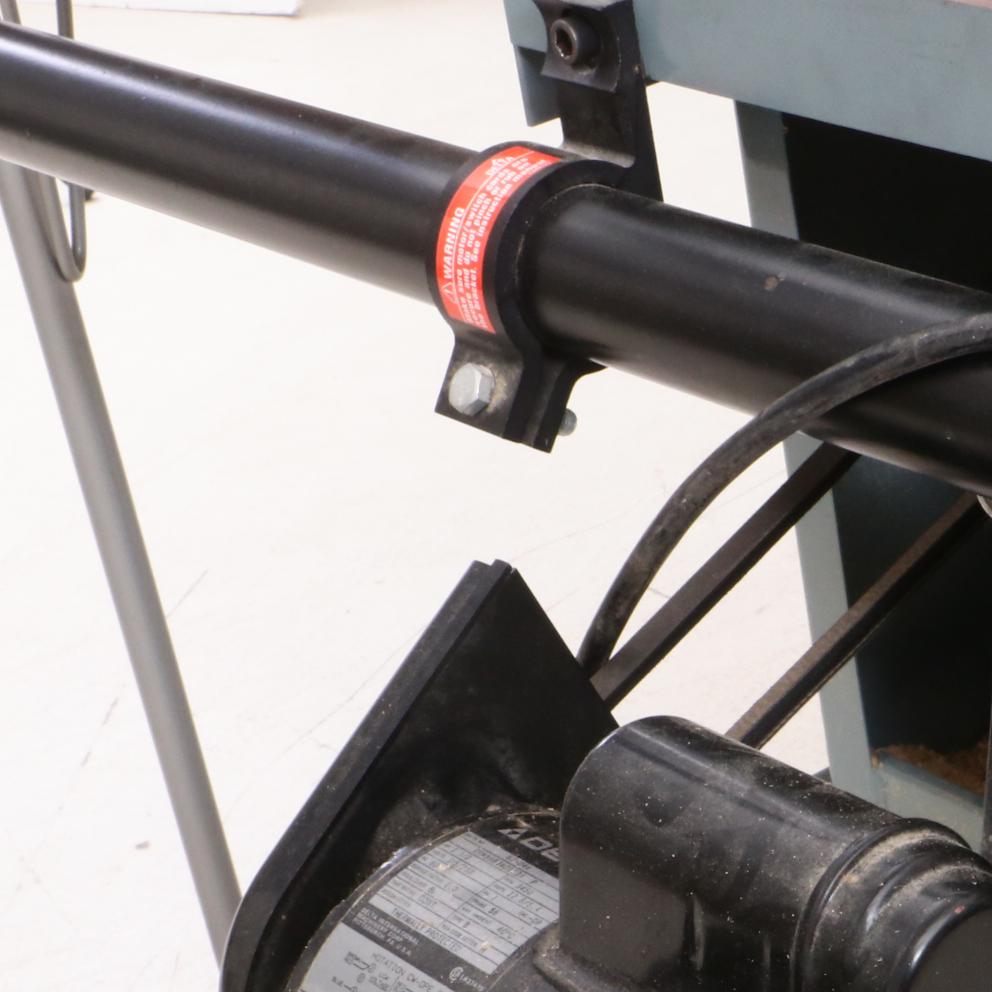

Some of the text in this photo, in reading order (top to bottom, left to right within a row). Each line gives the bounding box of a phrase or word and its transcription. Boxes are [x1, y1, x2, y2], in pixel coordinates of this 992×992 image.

[473, 198, 492, 230] pinch
[478, 183, 513, 238] instruction
[444, 207, 465, 279] WARNING
